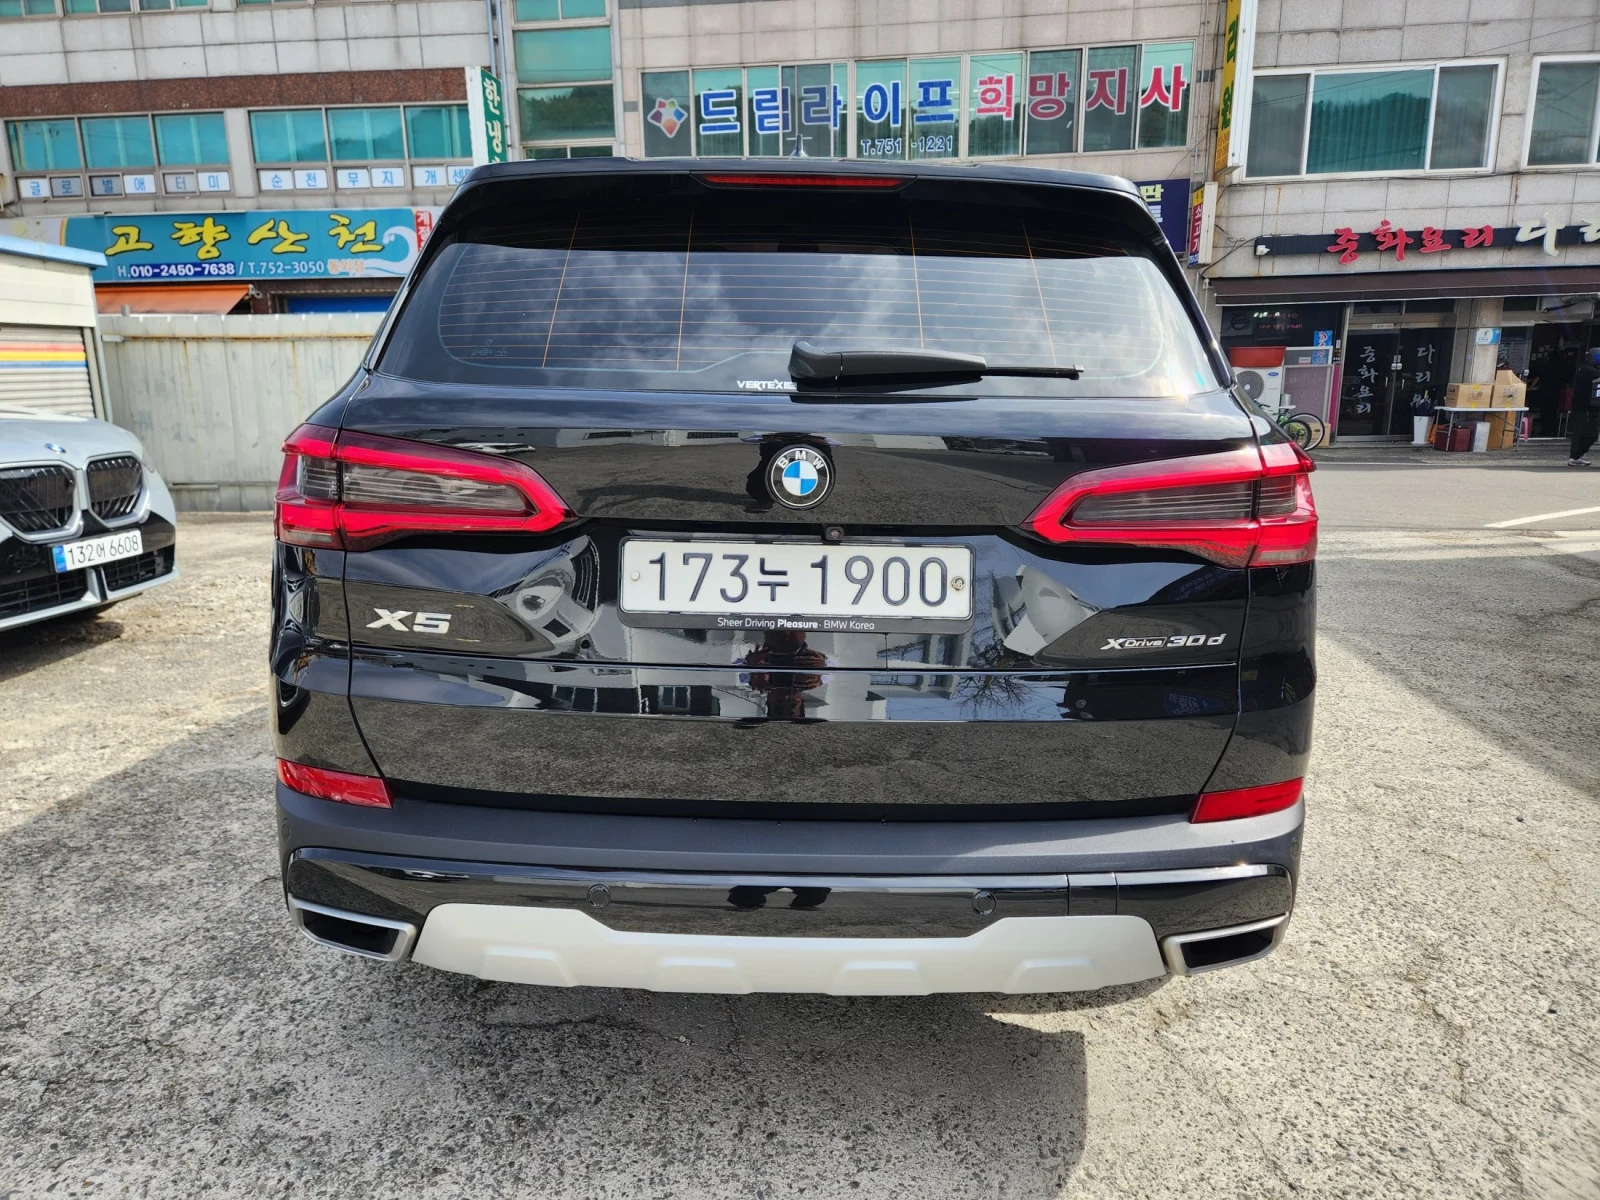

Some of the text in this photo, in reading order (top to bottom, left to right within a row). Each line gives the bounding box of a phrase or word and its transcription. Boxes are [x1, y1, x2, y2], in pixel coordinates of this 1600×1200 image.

[1221, 0, 1239, 130] 리원
[699, 63, 1187, 136] 드림라이프 희망지사
[104, 213, 385, 261] 고향산천
[1327, 219, 1494, 265] 중화요리
[249, 260, 325, 275] T.752-3050
[777, 450, 825, 470] BMW
[810, 554, 949, 607] 1900
[366, 607, 452, 634] X5
[717, 617, 743, 627] Sheer
[744, 617, 775, 630] Driving
[823, 619, 847, 630] BMW
[849, 620, 875, 630] Korea
